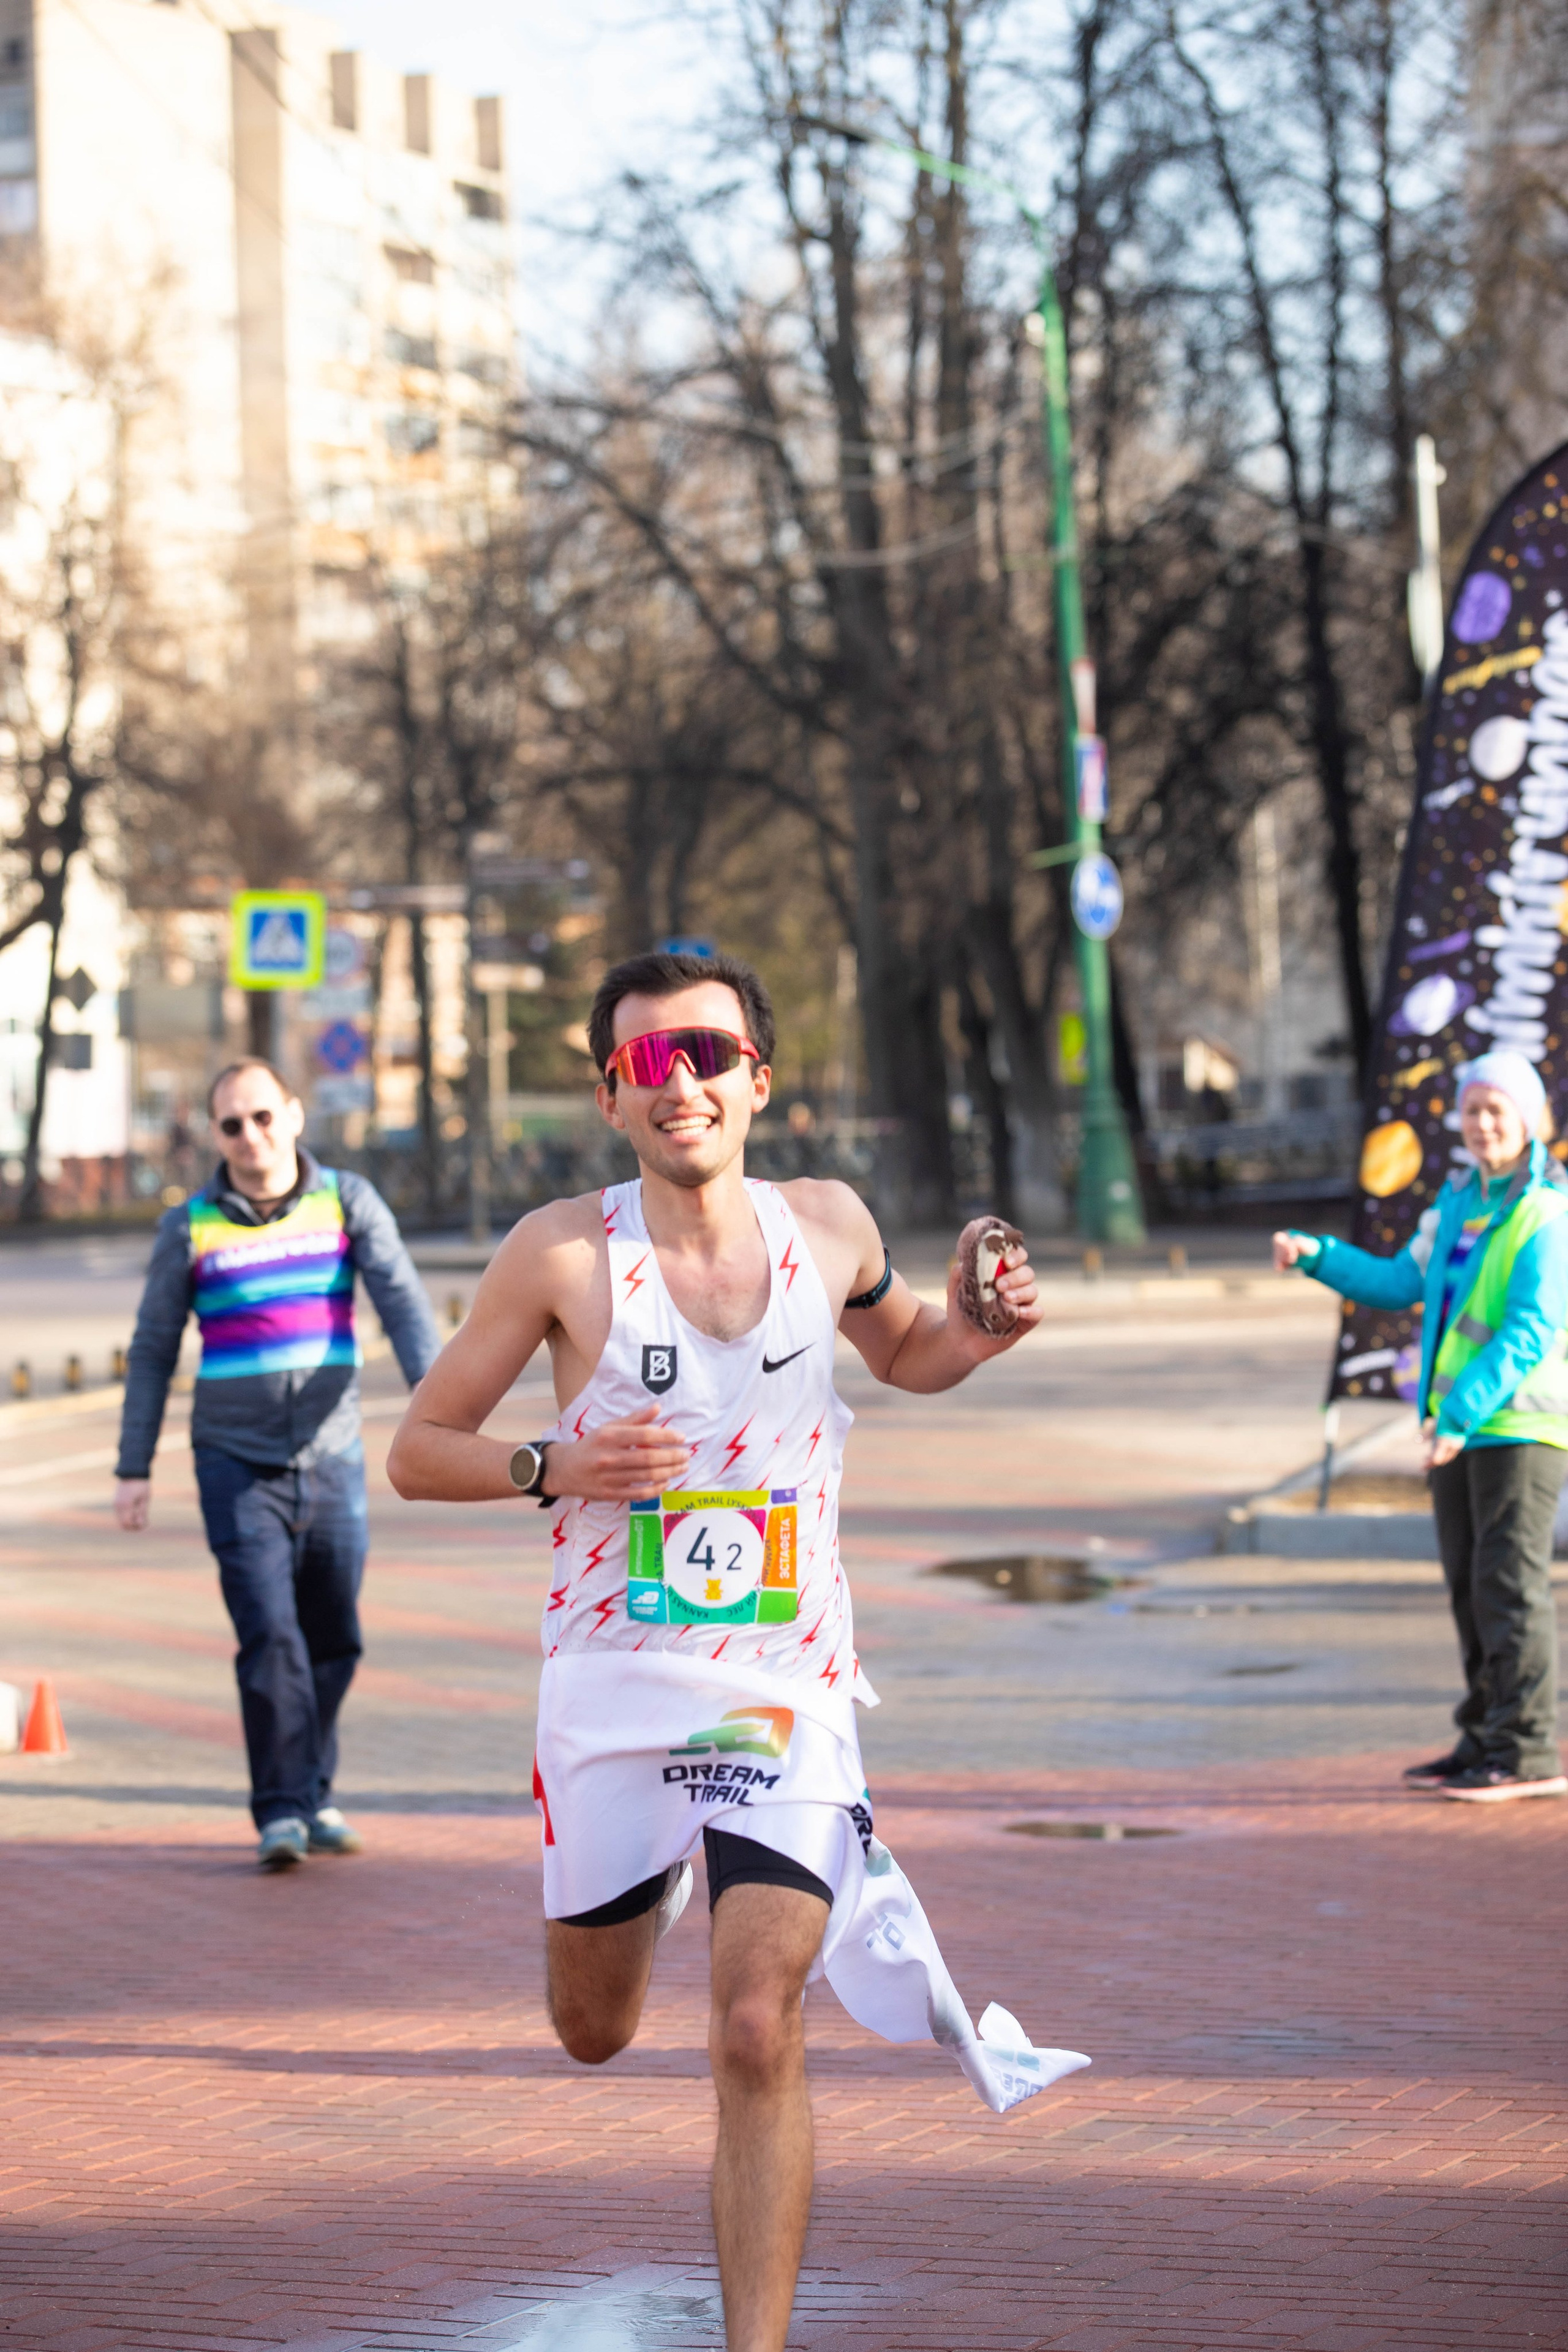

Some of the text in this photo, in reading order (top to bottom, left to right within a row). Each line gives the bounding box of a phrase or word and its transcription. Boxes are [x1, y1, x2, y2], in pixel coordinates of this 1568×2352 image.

[697, 1496, 724, 1507] TRAIL
[778, 1517, 791, 1580] ЭСТАФЕТА
[671, 1595, 709, 1619] KANNAS
[727, 1605, 745, 1618] ЛЕС
[662, 1763, 781, 1790] DREAM
[683, 1783, 755, 1807] TRAIL
